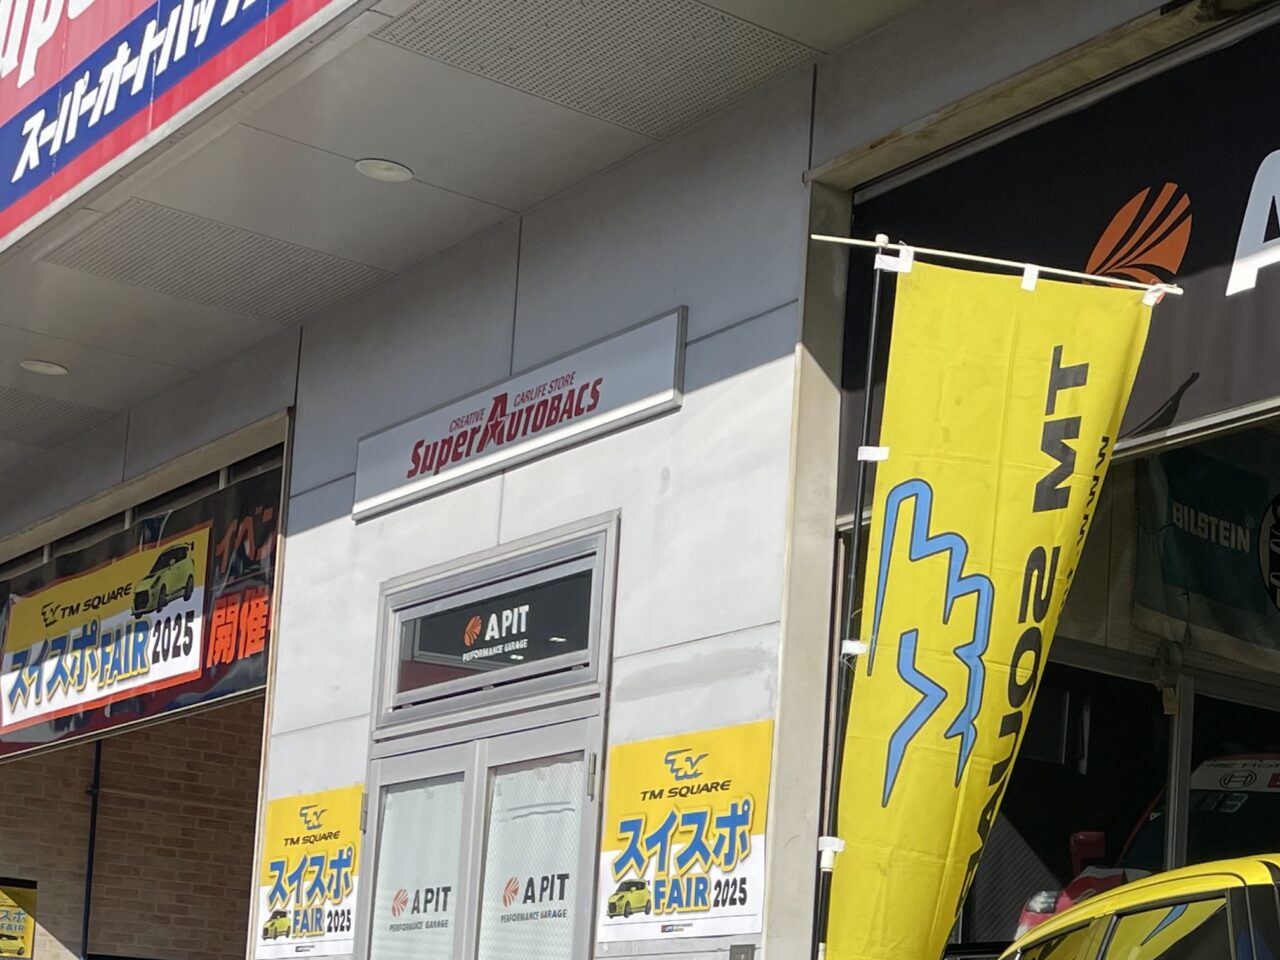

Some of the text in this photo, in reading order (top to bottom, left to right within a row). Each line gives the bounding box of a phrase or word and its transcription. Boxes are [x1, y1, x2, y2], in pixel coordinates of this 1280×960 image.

[449, 371, 577, 433] CREATIVE CARLIFE STORE
[1171, 499, 1251, 554] BILSTEIN
[60, 582, 134, 620] TM SQUARE
[206, 584, 272, 669] 開催
[501, 604, 530, 638] PIT
[7, 610, 196, 712] スイスポ FAIR 2025
[640, 779, 732, 802] TM SQUARE
[283, 831, 341, 847] TM SQUARE
[613, 798, 752, 876] スイスポ
[268, 845, 353, 906] スイスポ
[538, 873, 570, 903] PIT
[653, 875, 748, 911] FAIR 2025
[422, 886, 452, 914] PIT
[540, 909, 568, 920] GARAGE
[292, 906, 352, 935] FAIR 2025
[425, 919, 450, 930] GARAGE
